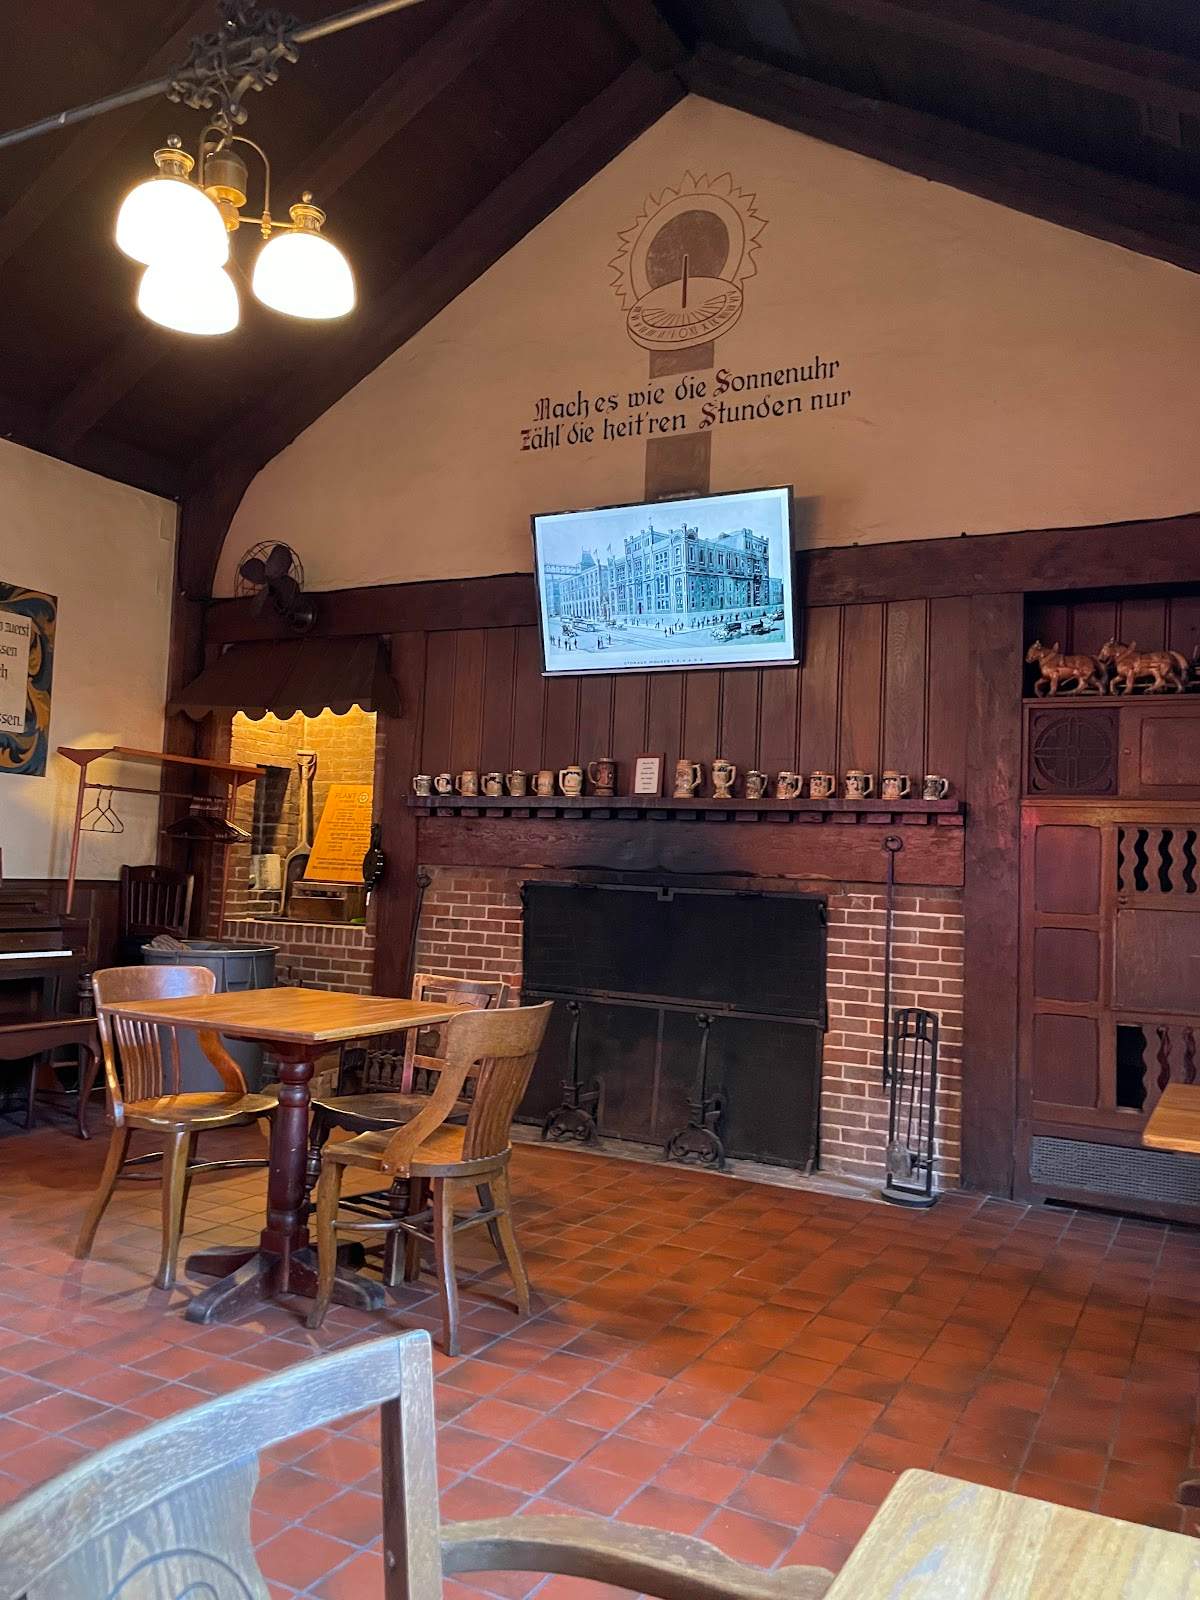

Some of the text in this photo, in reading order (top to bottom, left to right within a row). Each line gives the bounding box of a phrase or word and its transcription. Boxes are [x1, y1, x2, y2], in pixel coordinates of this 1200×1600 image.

[533, 355, 840, 422] Mach es wie die Sonnenuhr
[567, 421, 595, 445] die
[699, 394, 802, 430] Stunden
[811, 390, 851, 411] nur
